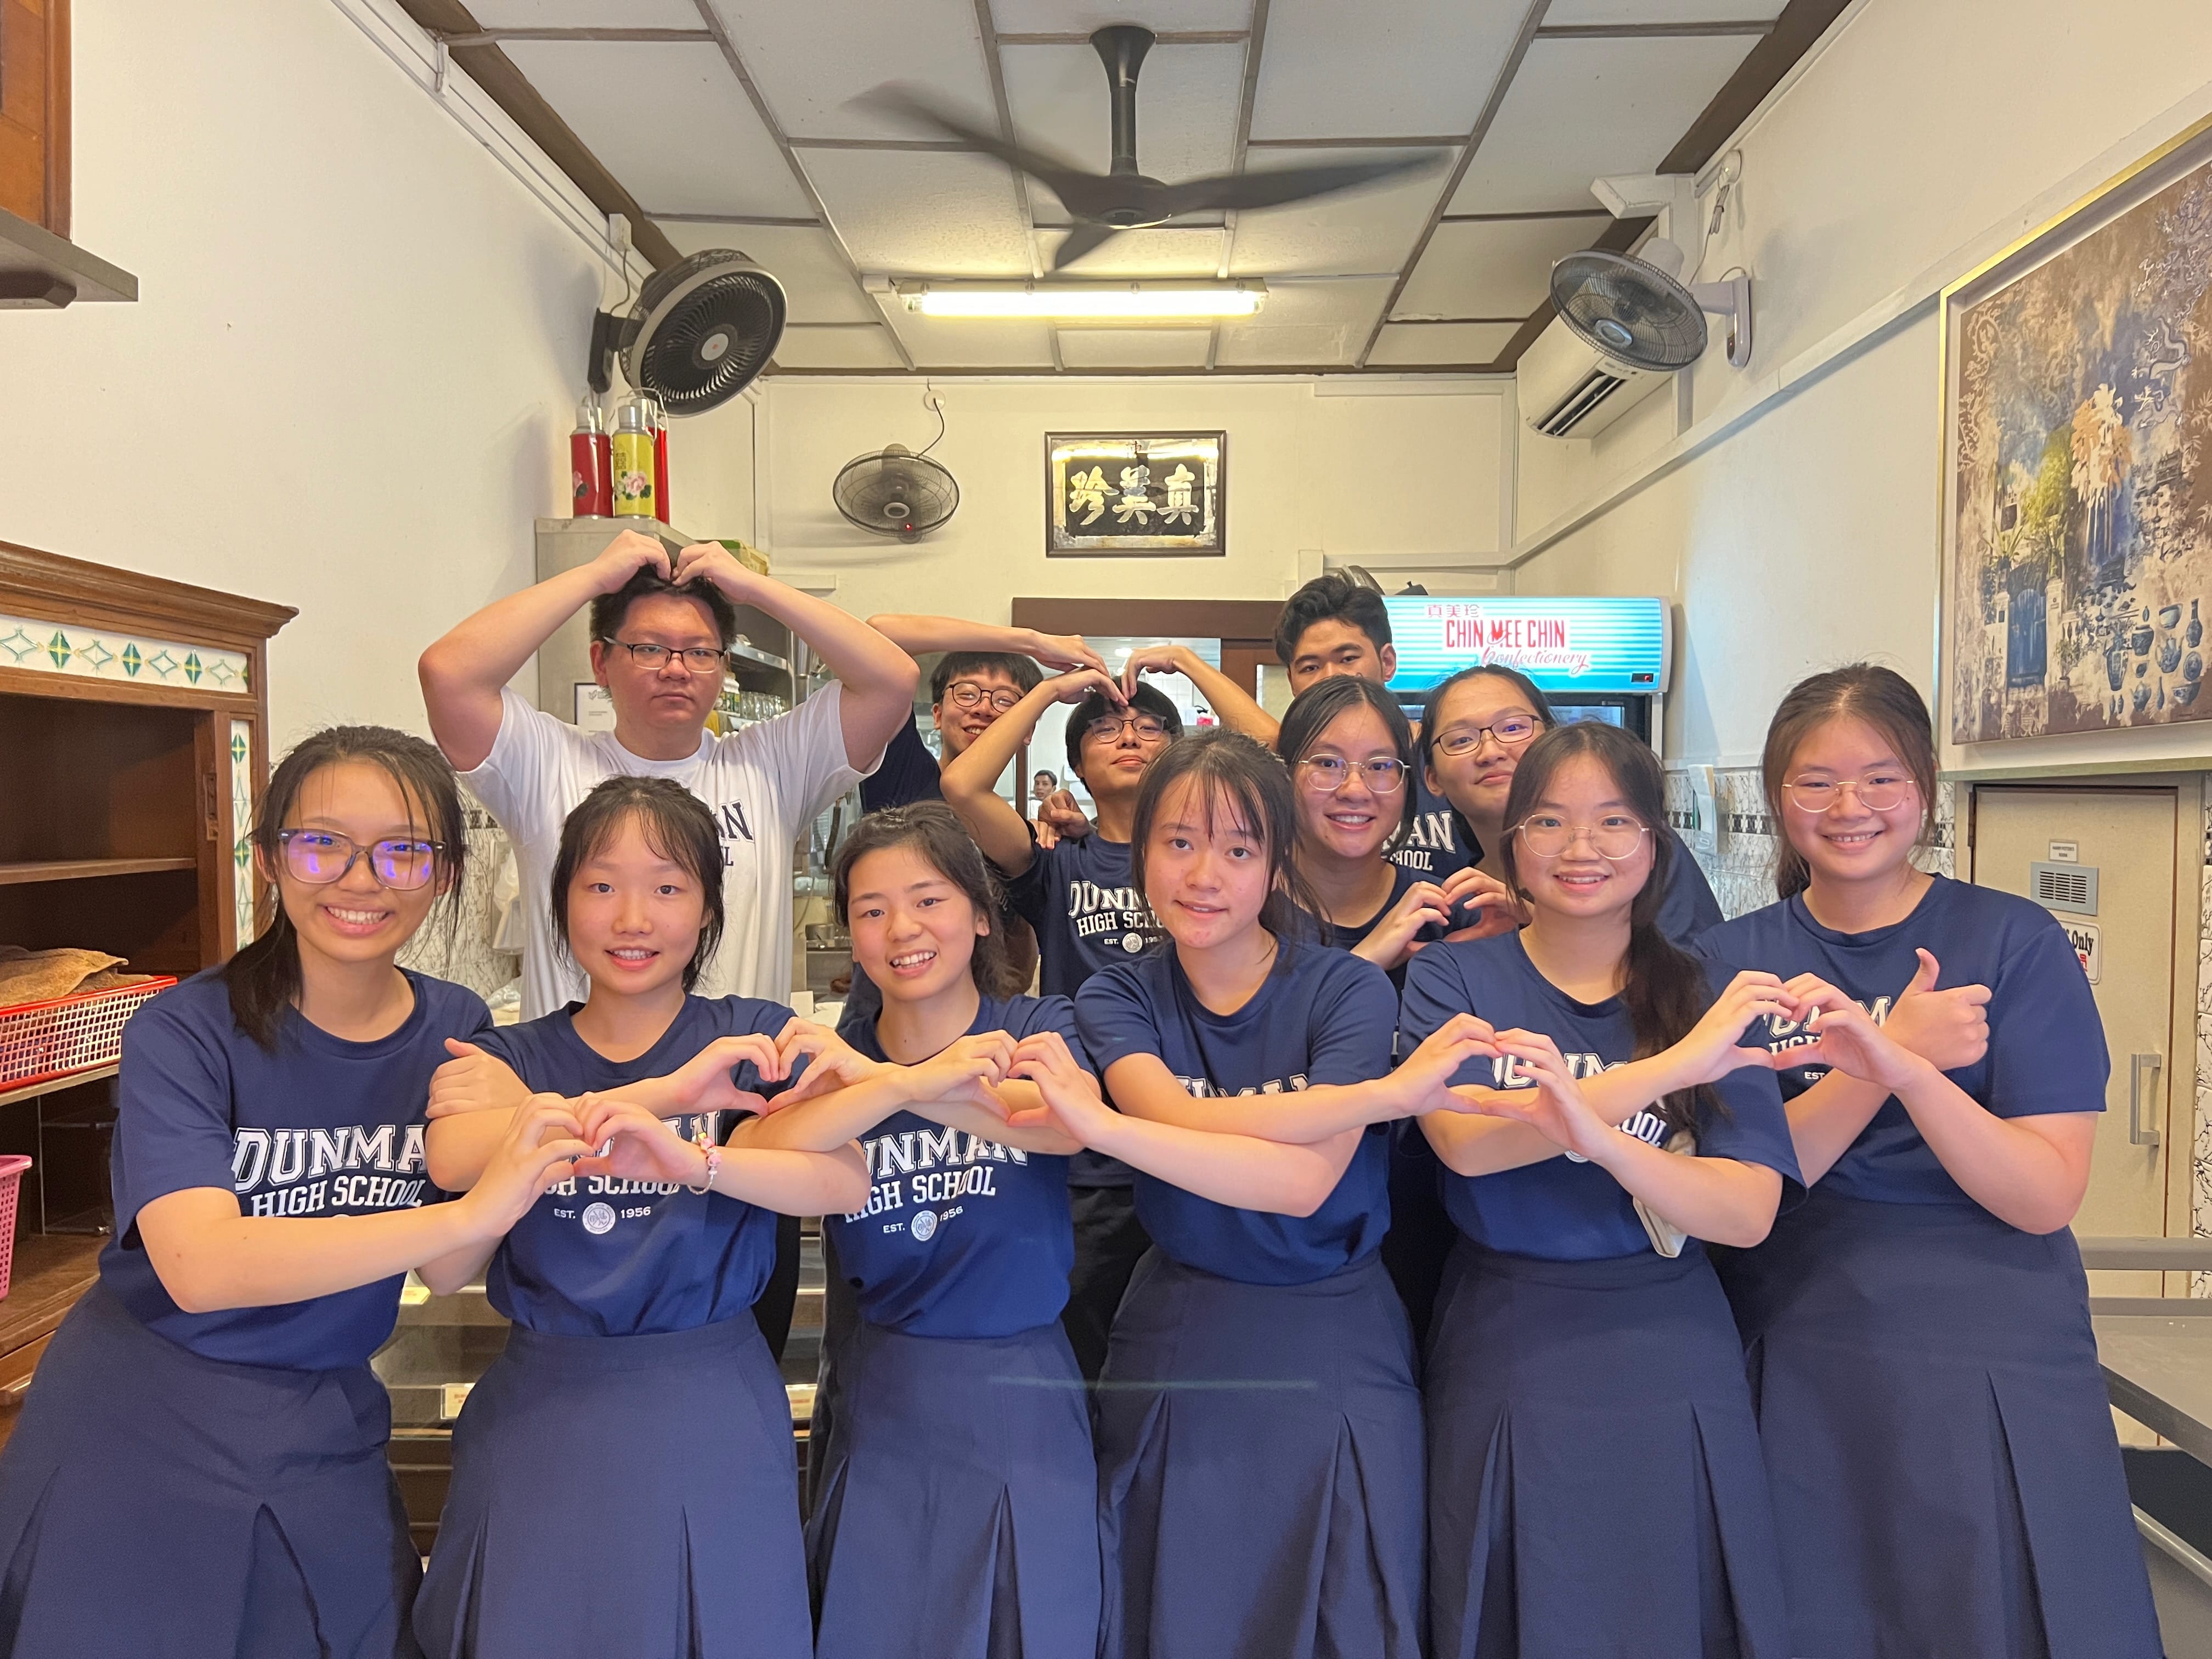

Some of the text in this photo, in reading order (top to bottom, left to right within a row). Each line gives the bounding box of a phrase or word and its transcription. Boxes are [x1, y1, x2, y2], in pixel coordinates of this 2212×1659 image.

[1427, 604, 1480, 618] 真美珍
[1446, 619, 1564, 648] CHIN MEE CHIN
[1076, 911, 1118, 937] HIGH
[2072, 930, 2094, 956] Only
[231, 1124, 426, 1194] DUNMA
[251, 1175, 426, 1217] HIGH SCHOOL
[912, 1166, 996, 1203] SCHOOL
[554, 1206, 651, 1219] EST. 1956
[883, 1223, 905, 1233] EST.
[940, 1206, 963, 1222] 1956
